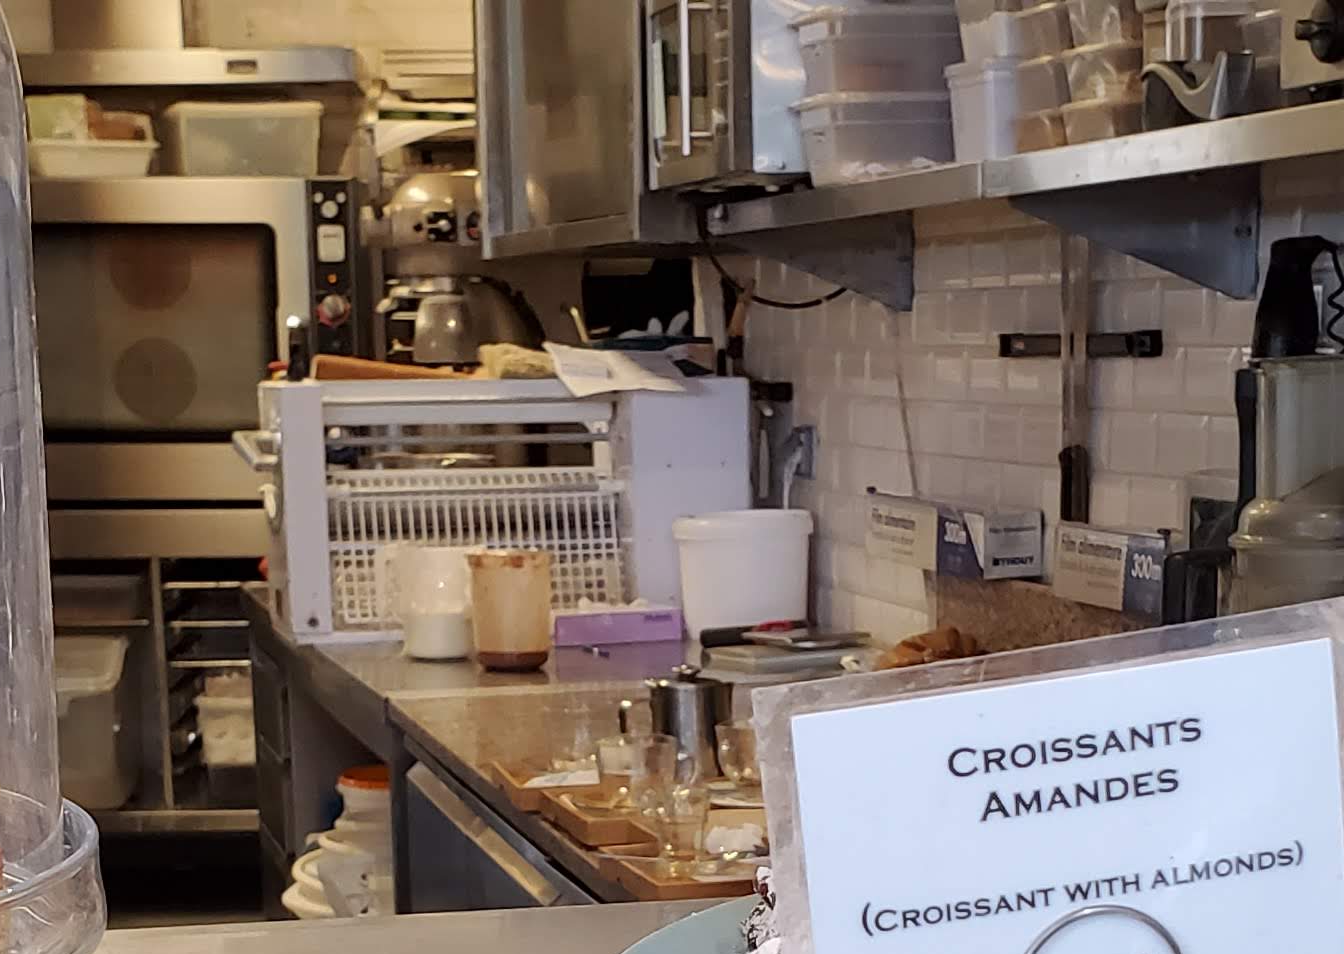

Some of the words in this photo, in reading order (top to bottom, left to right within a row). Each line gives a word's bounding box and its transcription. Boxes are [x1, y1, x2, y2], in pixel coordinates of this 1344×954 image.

[947, 717, 1202, 777] CROISSANTS
[980, 768, 1180, 821] AMANDES
[860, 887, 1057, 937] (CROISSANT
[1065, 873, 1142, 903] WITH
[1150, 840, 1304, 891] ALMONDS)
